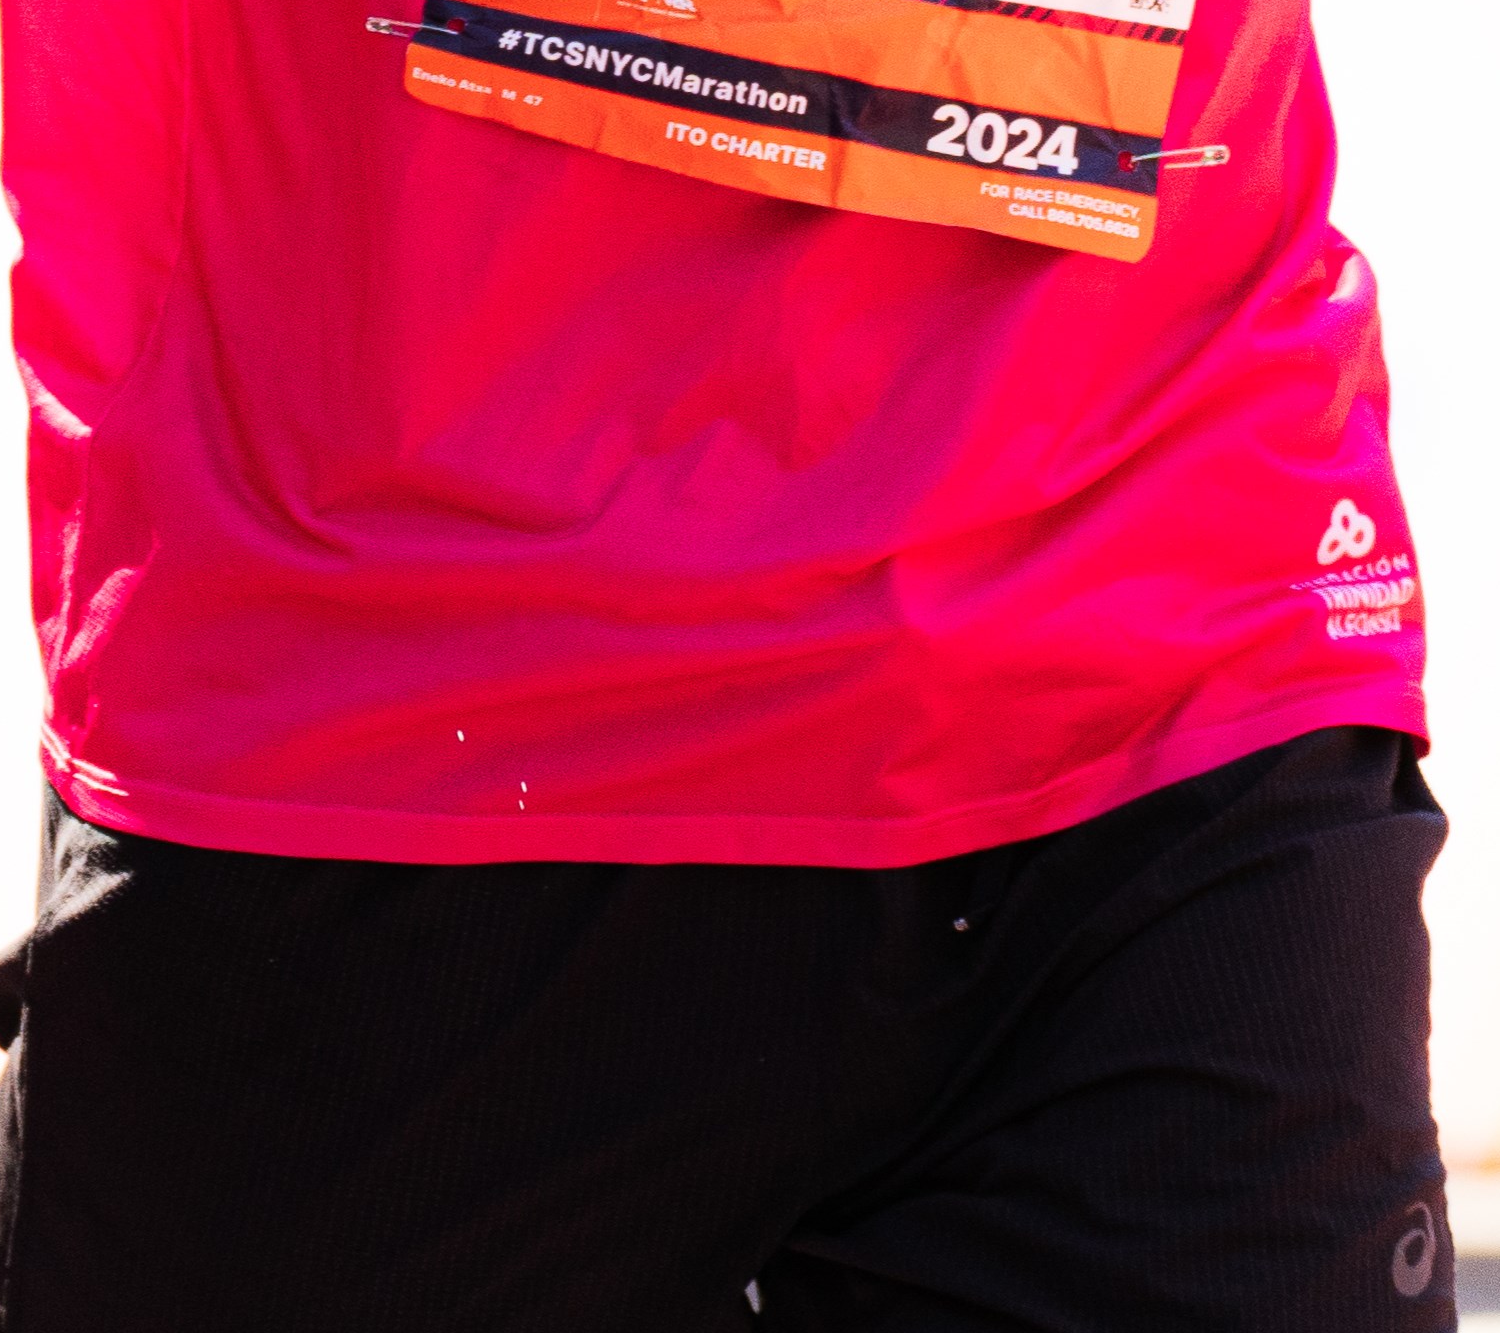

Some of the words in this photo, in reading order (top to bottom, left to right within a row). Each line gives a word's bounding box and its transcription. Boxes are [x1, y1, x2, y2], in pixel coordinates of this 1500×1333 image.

[412, 67, 456, 87] Eneko
[501, 89, 517, 101] M
[523, 95, 544, 106] 47
[497, 28, 808, 116] #TCSNYCMarathon
[665, 121, 707, 147] ITO
[710, 131, 827, 173] CHARTER
[926, 105, 1080, 176] 2024
[980, 182, 1010, 199] FOR
[1013, 186, 1055, 203] RACE
[1009, 203, 1046, 220] CALL
